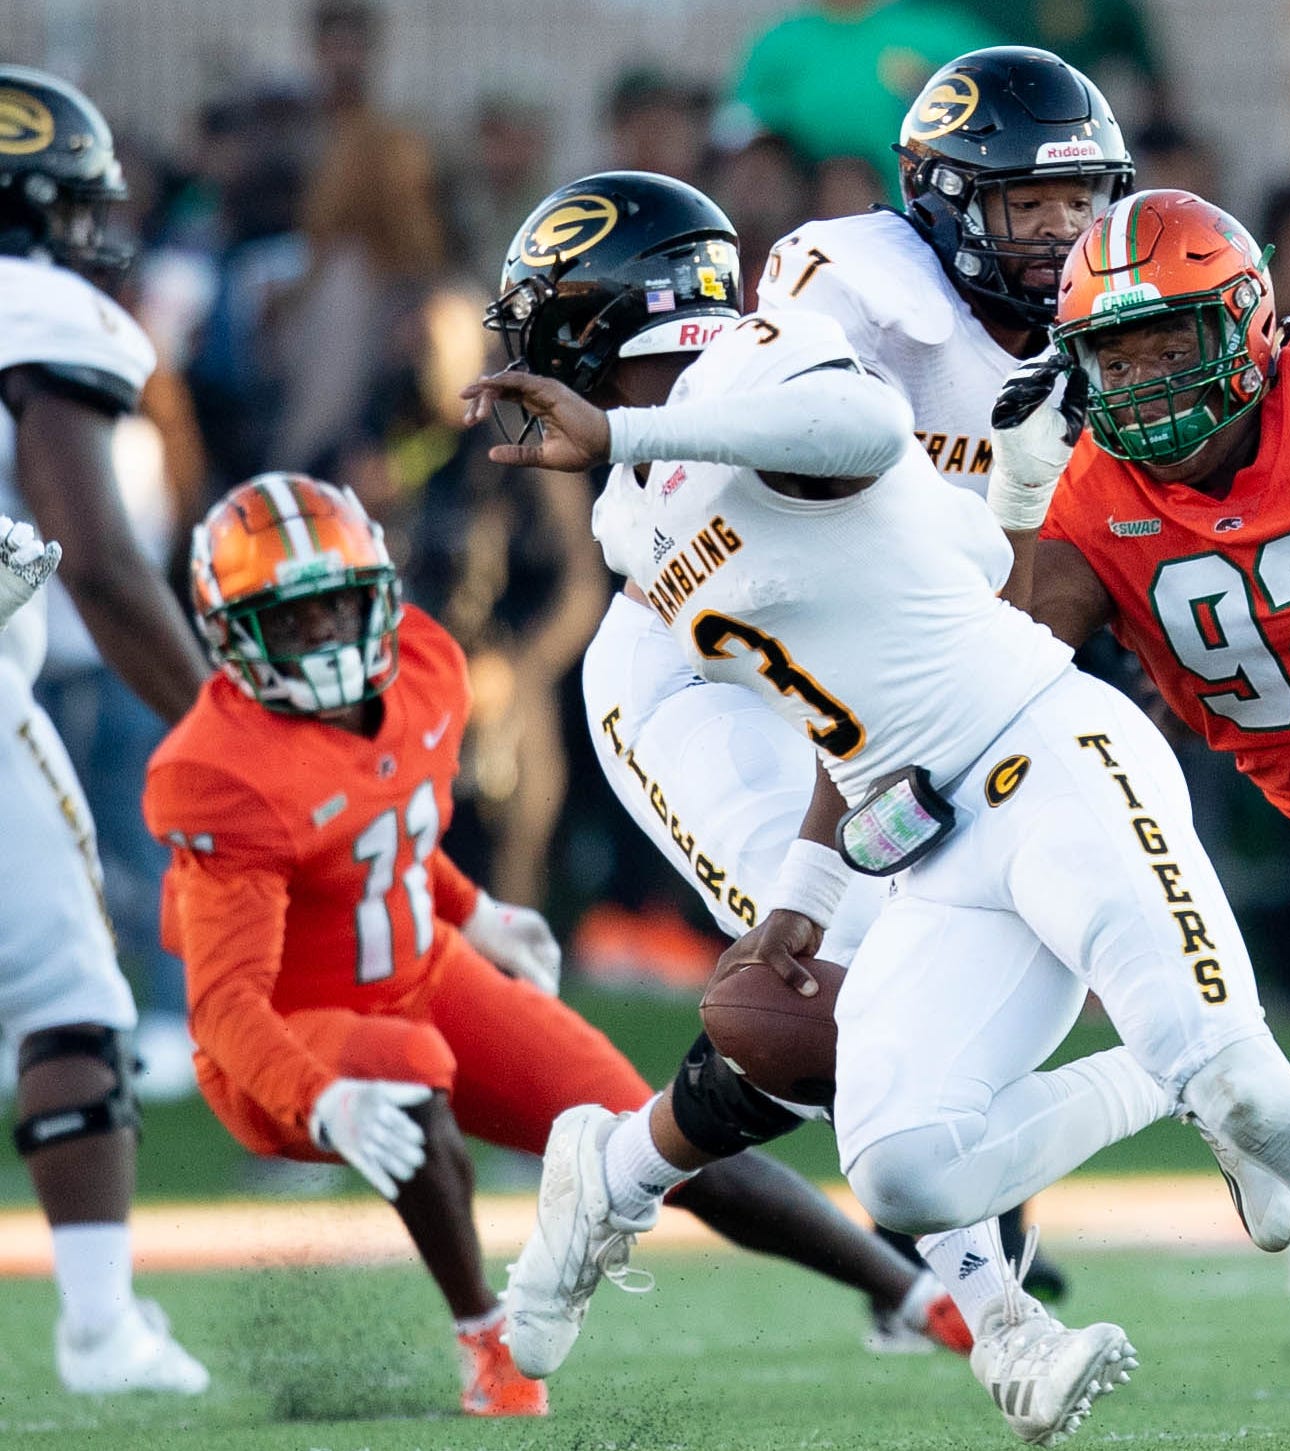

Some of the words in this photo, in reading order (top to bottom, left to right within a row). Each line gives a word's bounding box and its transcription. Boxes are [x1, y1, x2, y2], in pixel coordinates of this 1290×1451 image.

[914, 431, 994, 475] RAM
[1119, 519, 1161, 536] SWAC
[648, 514, 744, 628] RAMBLING
[691, 609, 867, 762] 3
[352, 778, 440, 987] 11
[602, 705, 758, 929] TIGERS
[1075, 732, 1228, 1005] TIGERS
